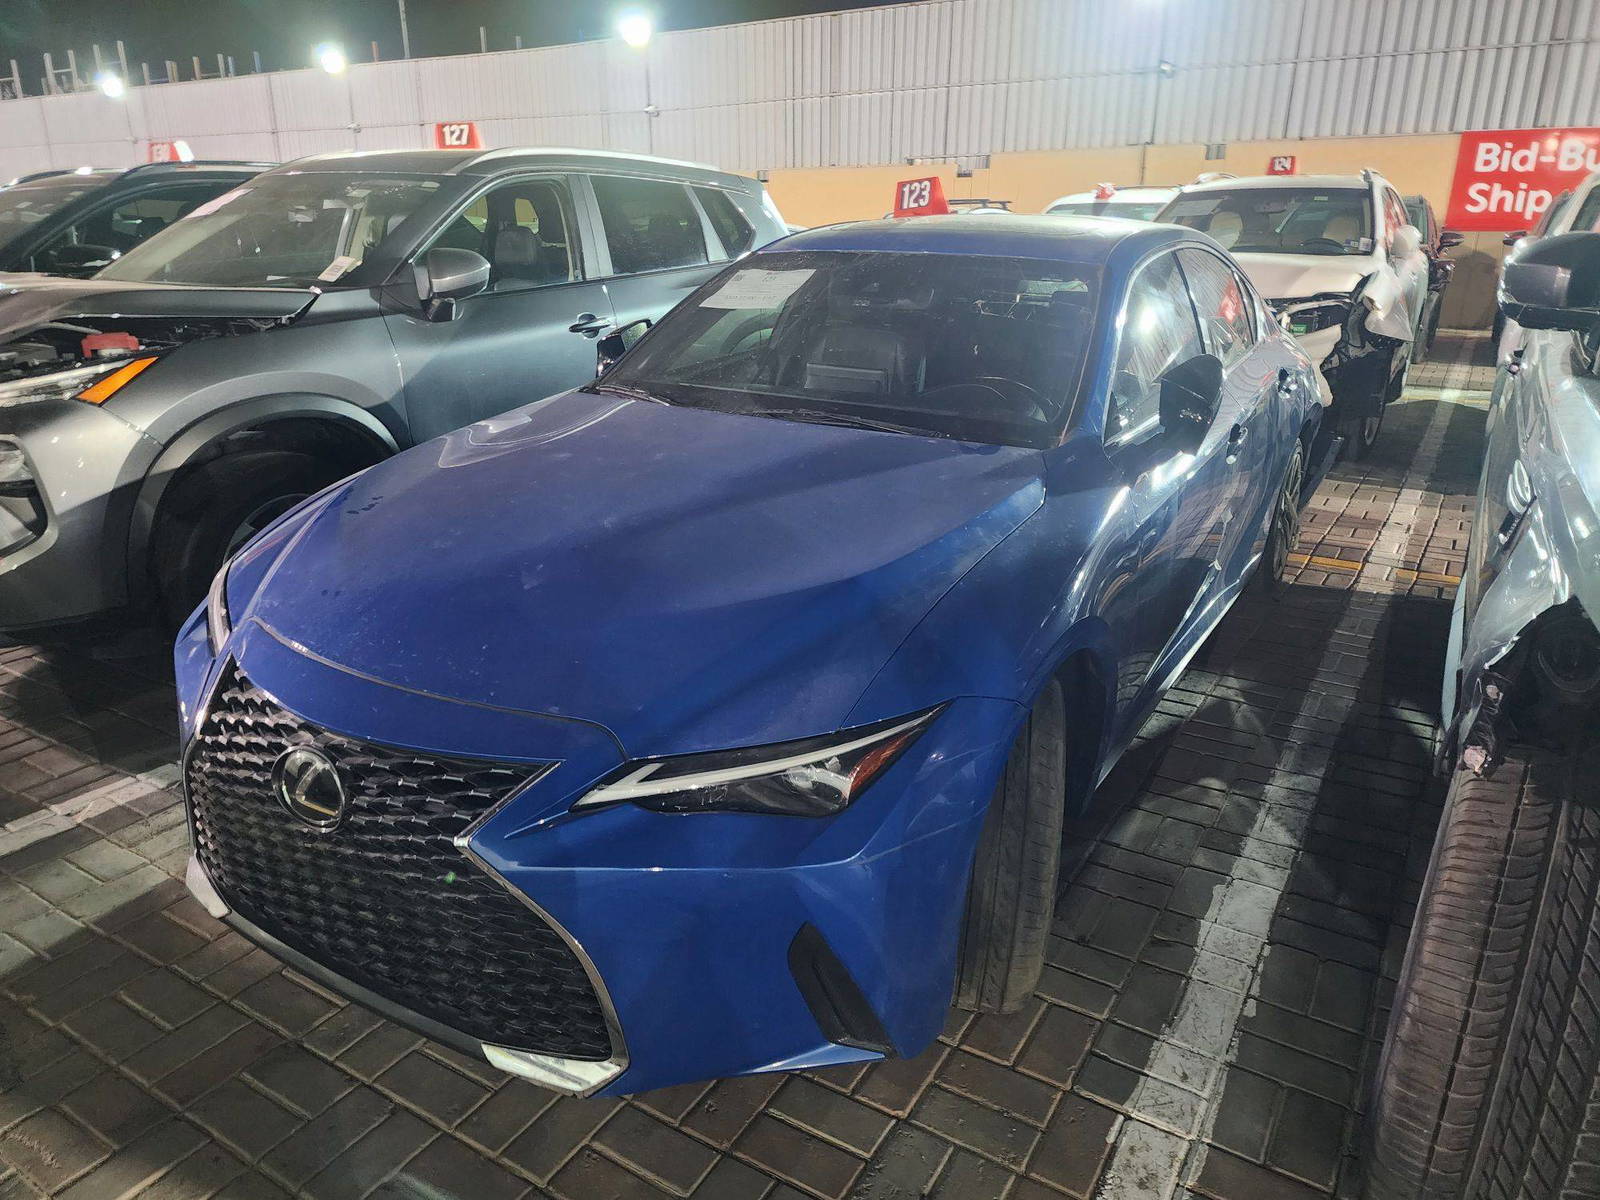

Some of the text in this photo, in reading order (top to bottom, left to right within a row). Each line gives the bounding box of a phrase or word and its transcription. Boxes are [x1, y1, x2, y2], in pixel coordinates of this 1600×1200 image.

[442, 123, 470, 146] 127
[902, 180, 931, 209] 123
[1464, 182, 1553, 221] Ship
